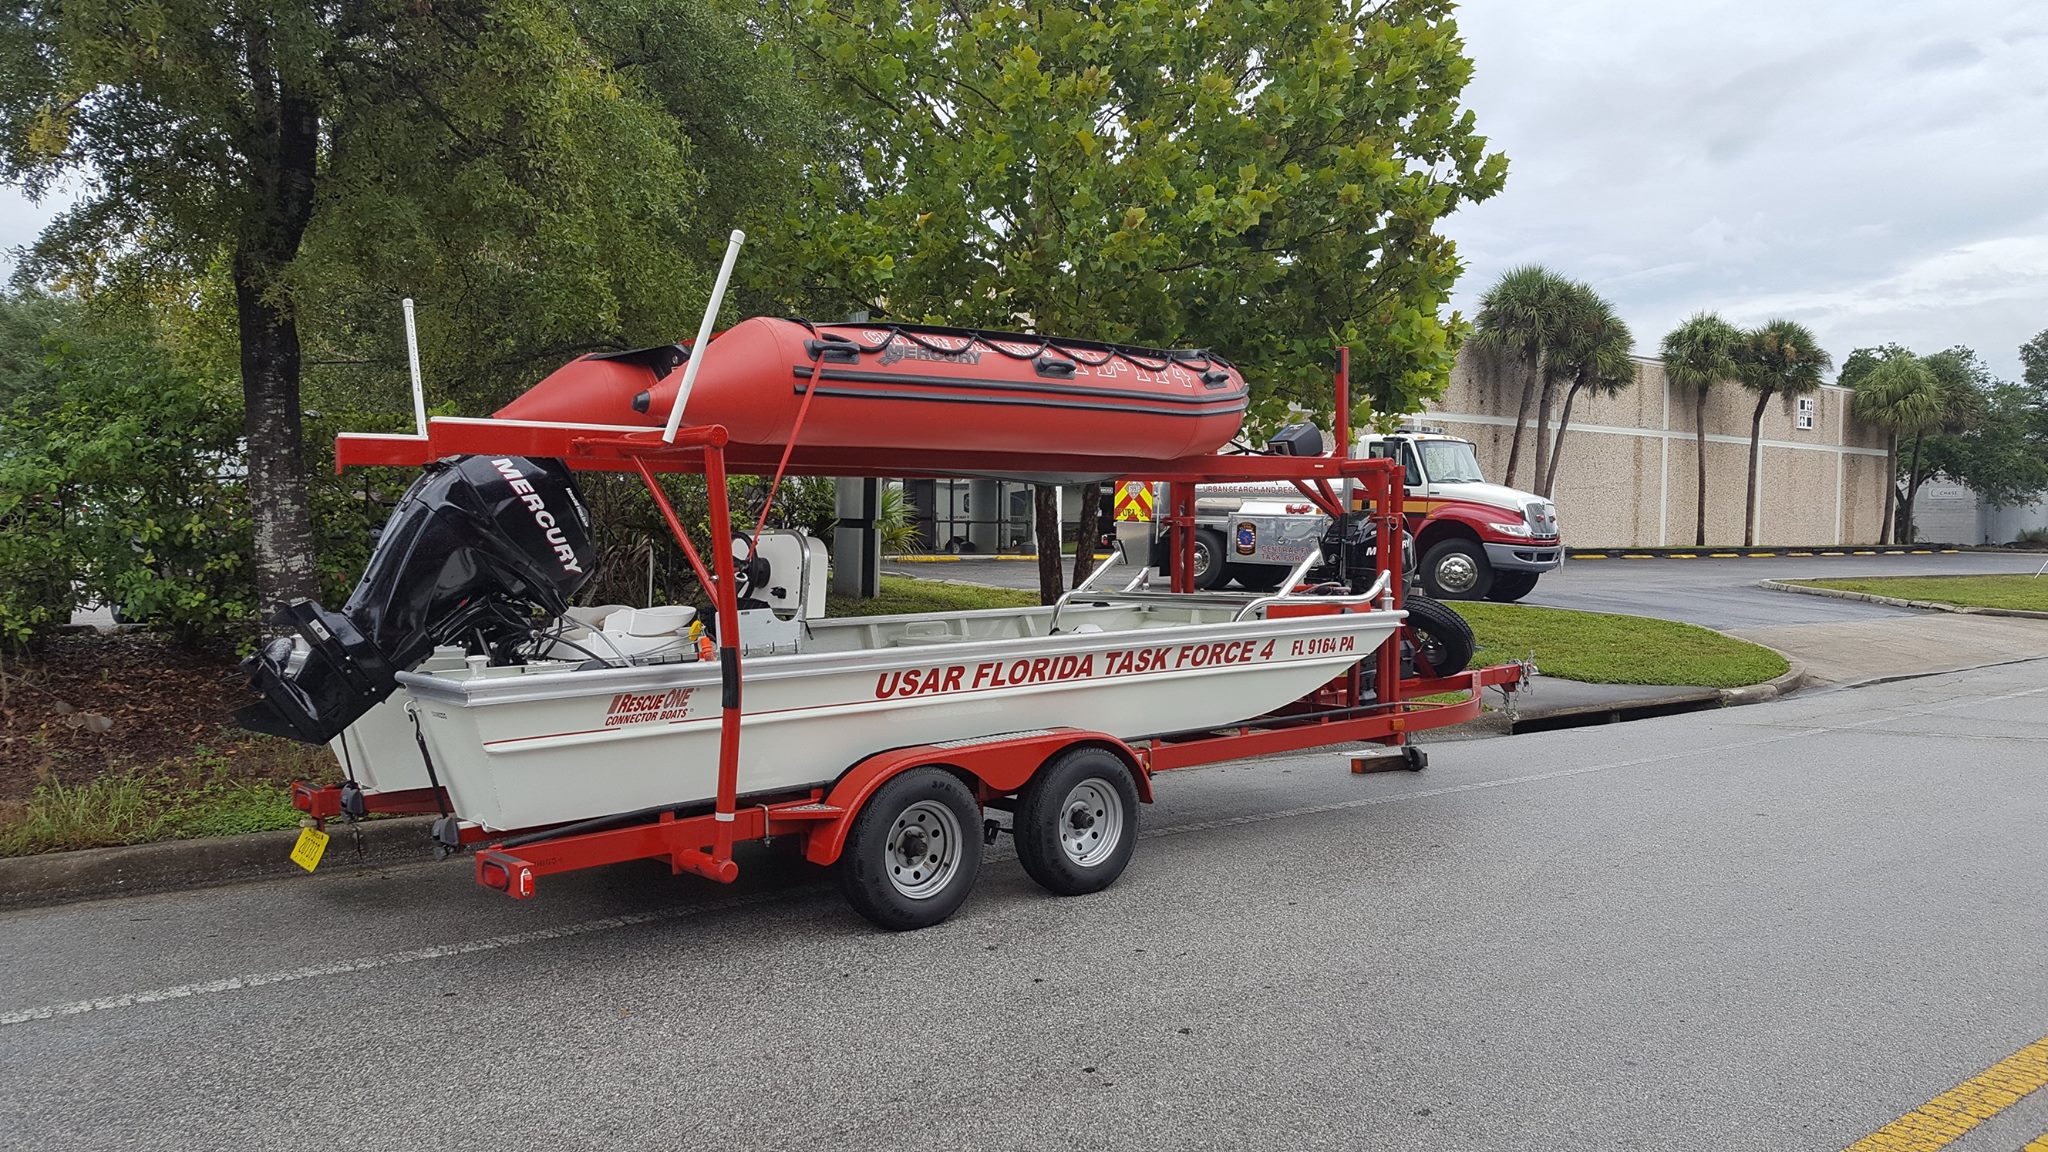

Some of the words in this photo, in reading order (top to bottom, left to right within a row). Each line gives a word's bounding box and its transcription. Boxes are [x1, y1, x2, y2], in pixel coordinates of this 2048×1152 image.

[1203, 485, 1228, 493] URBAN
[1229, 485, 1258, 493] SEARCH
[1259, 486, 1277, 494] AND
[1279, 486, 1299, 494] RESC
[491, 458, 583, 574] MERCURY
[1261, 553, 1280, 561] TASK
[1284, 554, 1306, 562] FORC
[1291, 640, 1305, 656] FL
[1308, 637, 1337, 655] 9164
[1339, 635, 1355, 652] PA
[875, 665, 965, 699] USAR
[971, 654, 1094, 689] FLORIDA
[1105, 647, 1173, 676] TASK
[1175, 640, 1257, 669] FORCE
[1259, 638, 1277, 661] 4
[605, 712, 659, 726] CONNECTOR
[660, 708, 689, 720] BOATS
